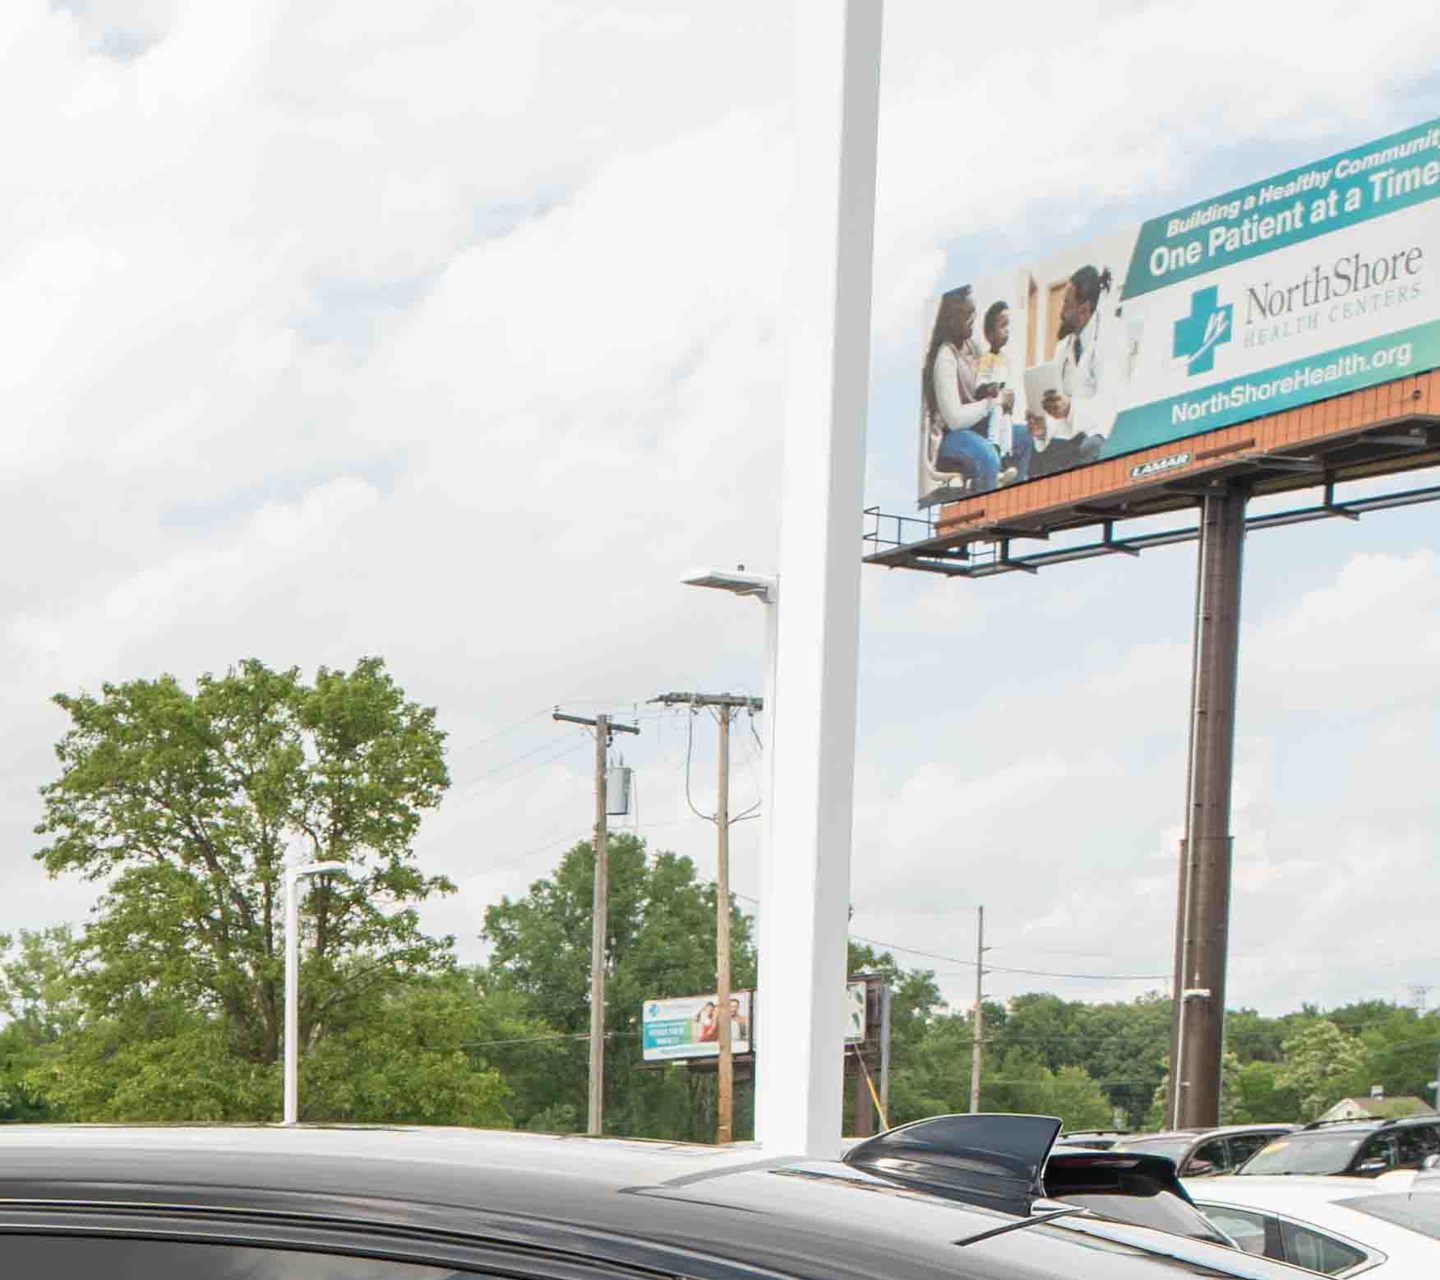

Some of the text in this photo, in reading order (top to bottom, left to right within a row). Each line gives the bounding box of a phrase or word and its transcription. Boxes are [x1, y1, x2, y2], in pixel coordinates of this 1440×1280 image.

[1149, 240, 1202, 276] One
[1207, 200, 1305, 257] Patient
[1309, 188, 1340, 224] at
[1344, 186, 1362, 212] a
[1166, 200, 1241, 238] Building
[1243, 194, 1256, 210] a
[1258, 168, 1333, 205] Healthy
[1243, 282, 1422, 348] HEALTH CENTERS
[1244, 246, 1423, 325] NorthShore
[1171, 341, 1413, 425] NorthShoreHealth.org
